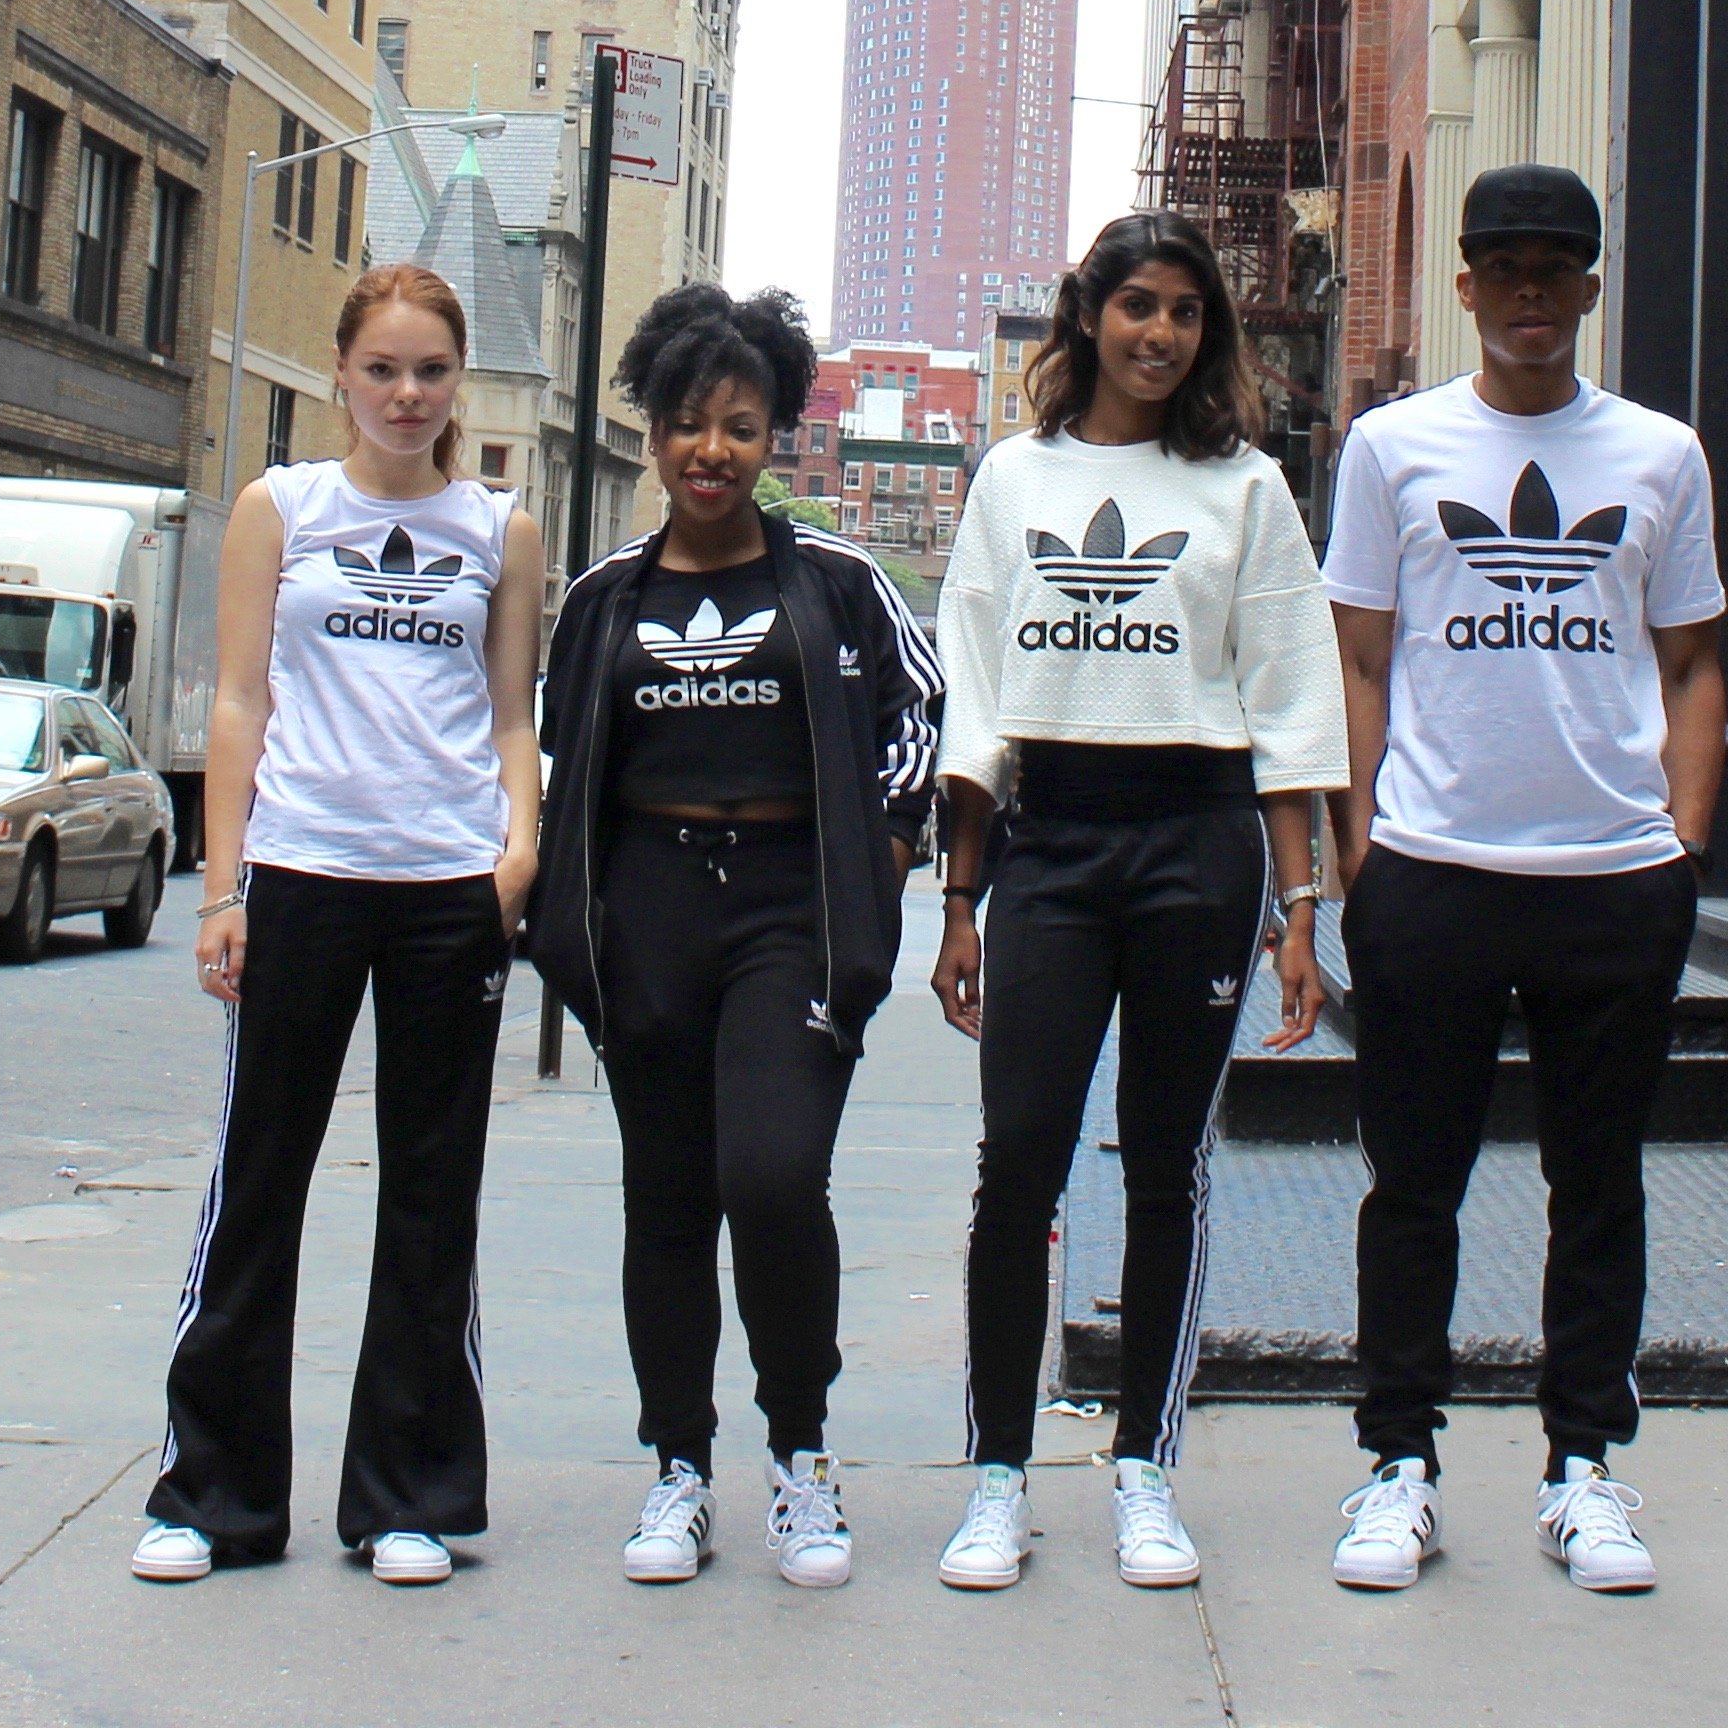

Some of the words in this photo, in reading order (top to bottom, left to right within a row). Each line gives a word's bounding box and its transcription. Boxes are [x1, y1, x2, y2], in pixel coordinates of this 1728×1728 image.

[631, 56, 653, 69] Truck
[630, 72, 661, 88] Loading
[629, 85, 648, 99] Only
[614, 108, 628, 121] day
[638, 112, 661, 127] Friday
[623, 127, 639, 140] 7pm
[325, 608, 464, 648] adidas
[1018, 611, 1180, 654] adidas
[1444, 603, 1614, 653] adidas
[635, 675, 781, 711] adidas
